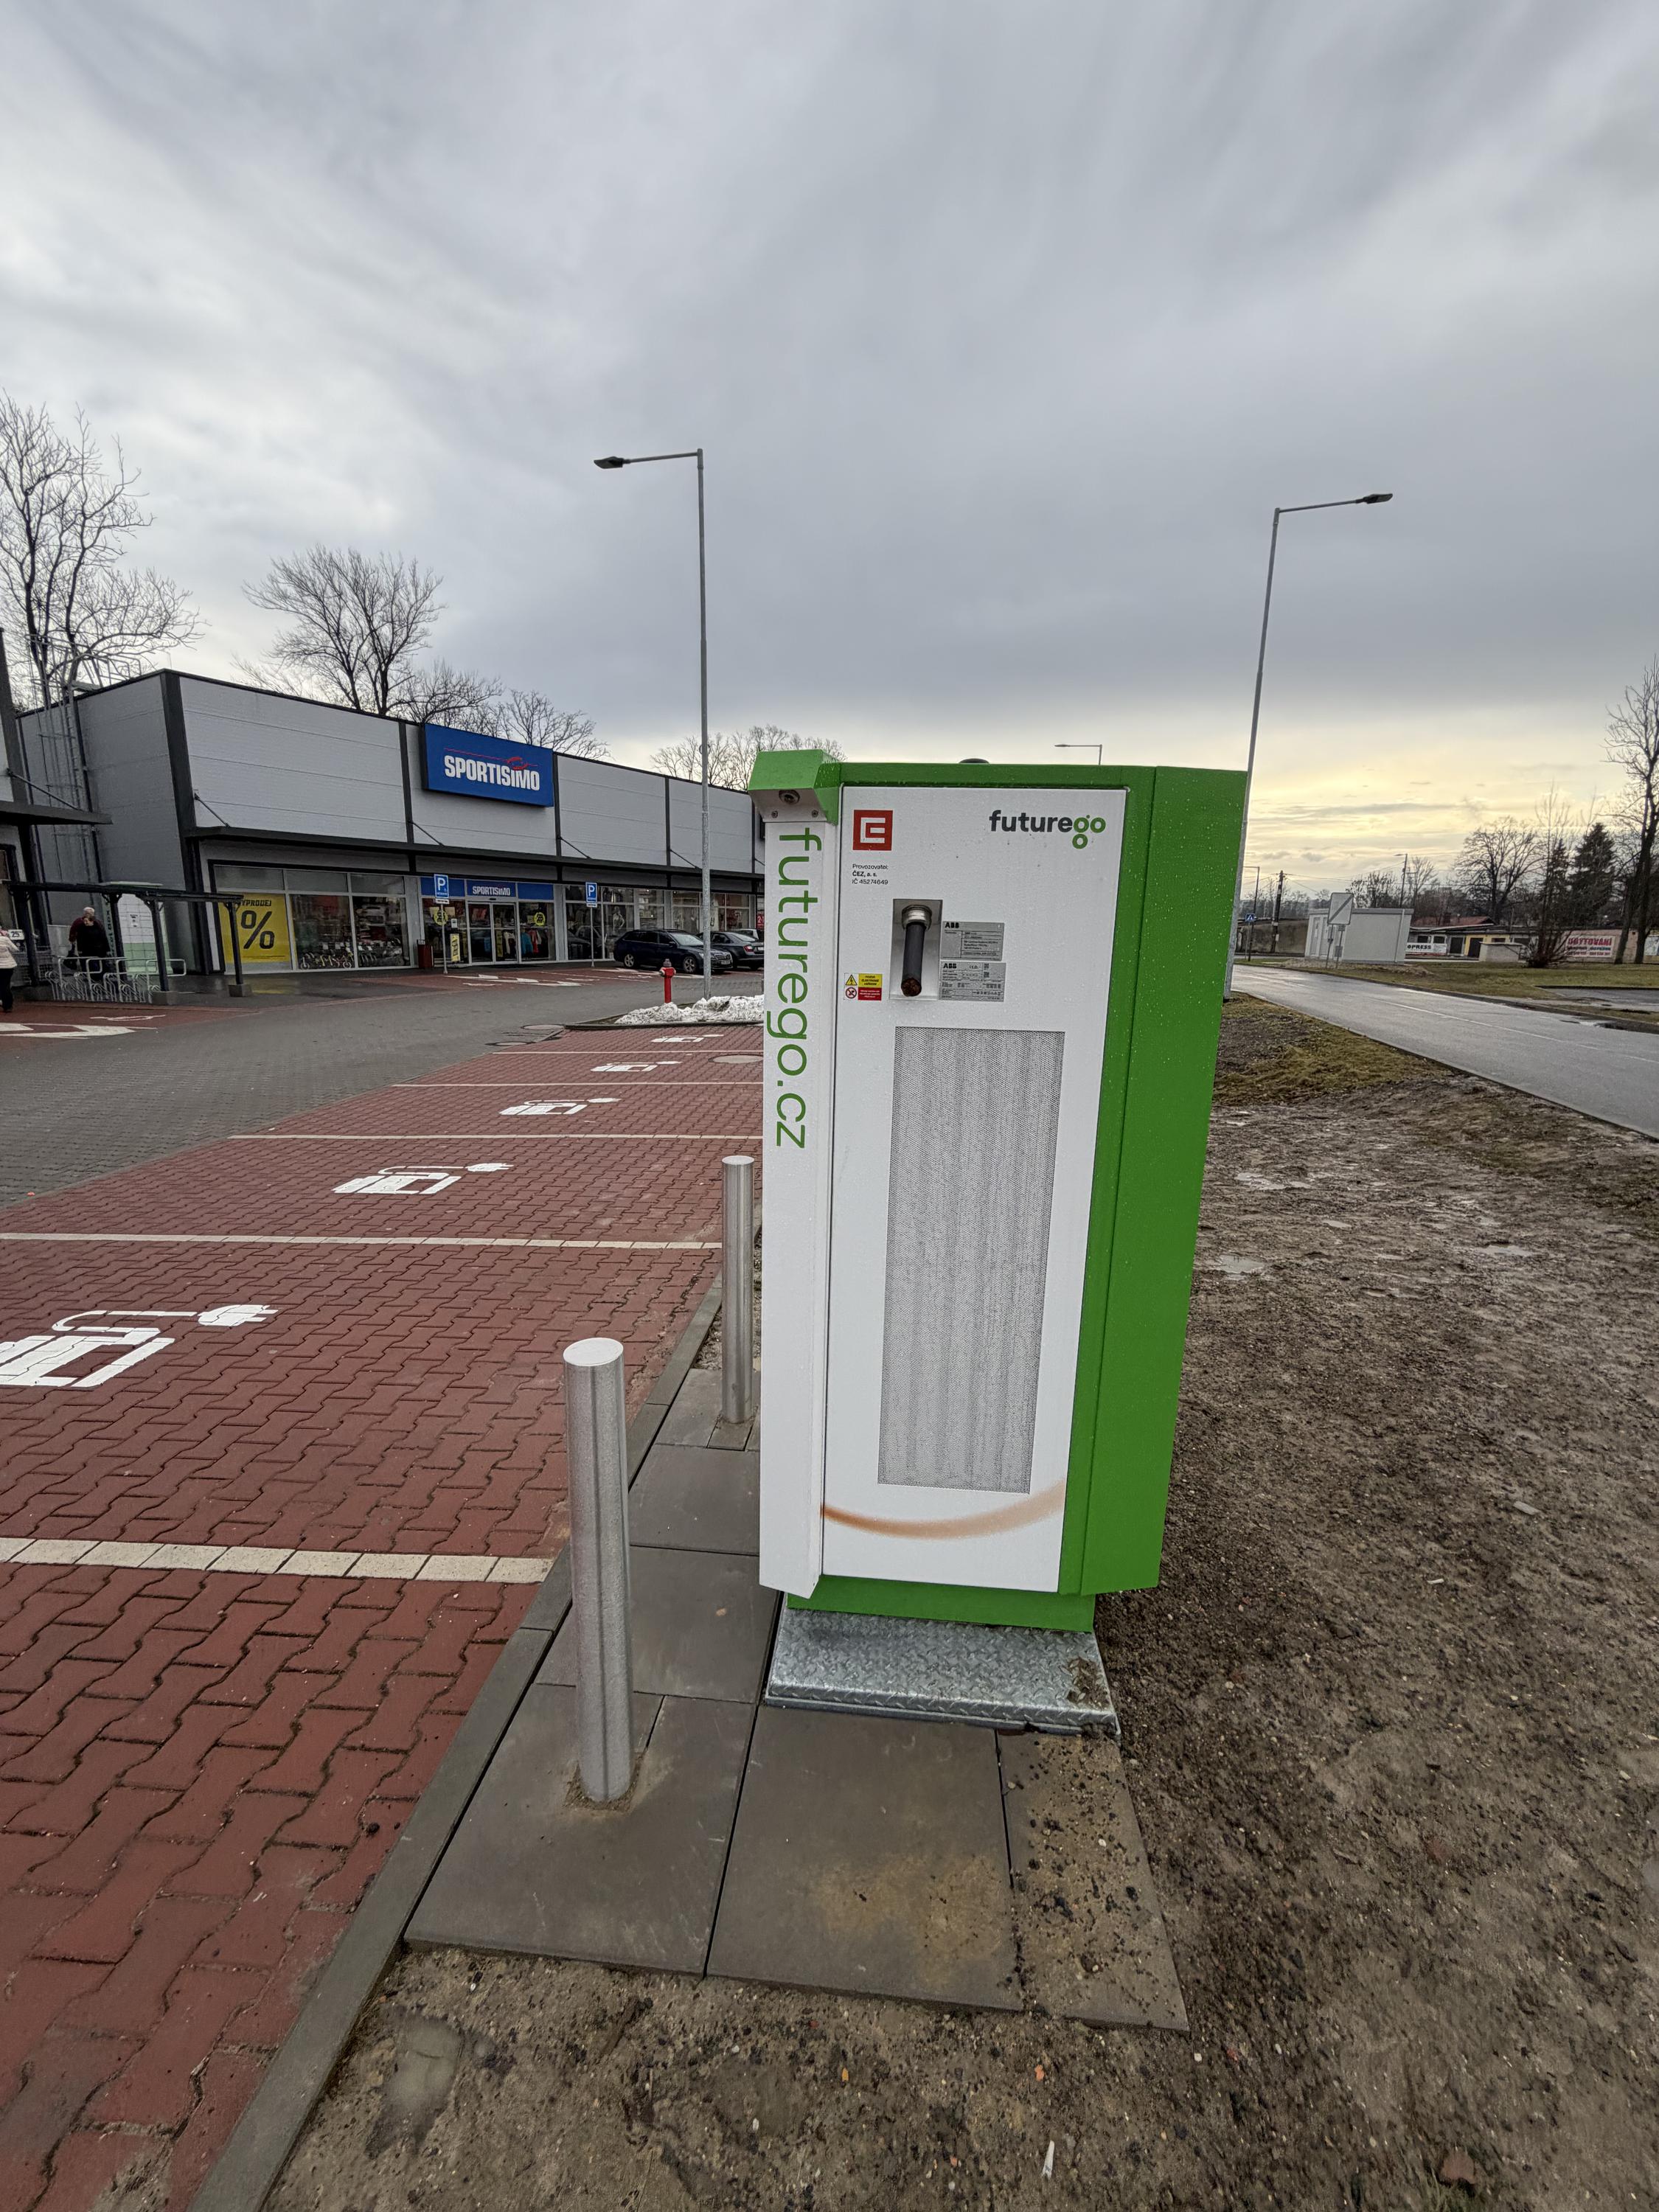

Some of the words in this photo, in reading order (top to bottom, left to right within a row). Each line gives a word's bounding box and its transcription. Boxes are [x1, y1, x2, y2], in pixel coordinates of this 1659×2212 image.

[444, 755, 540, 791] SPORTISIMO
[989, 810, 1106, 849] futurego
[438, 877, 445, 891] P
[473, 886, 510, 896] SPORTISIMO
[588, 885, 595, 897] P
[767, 827, 822, 1149] futurego.cz
